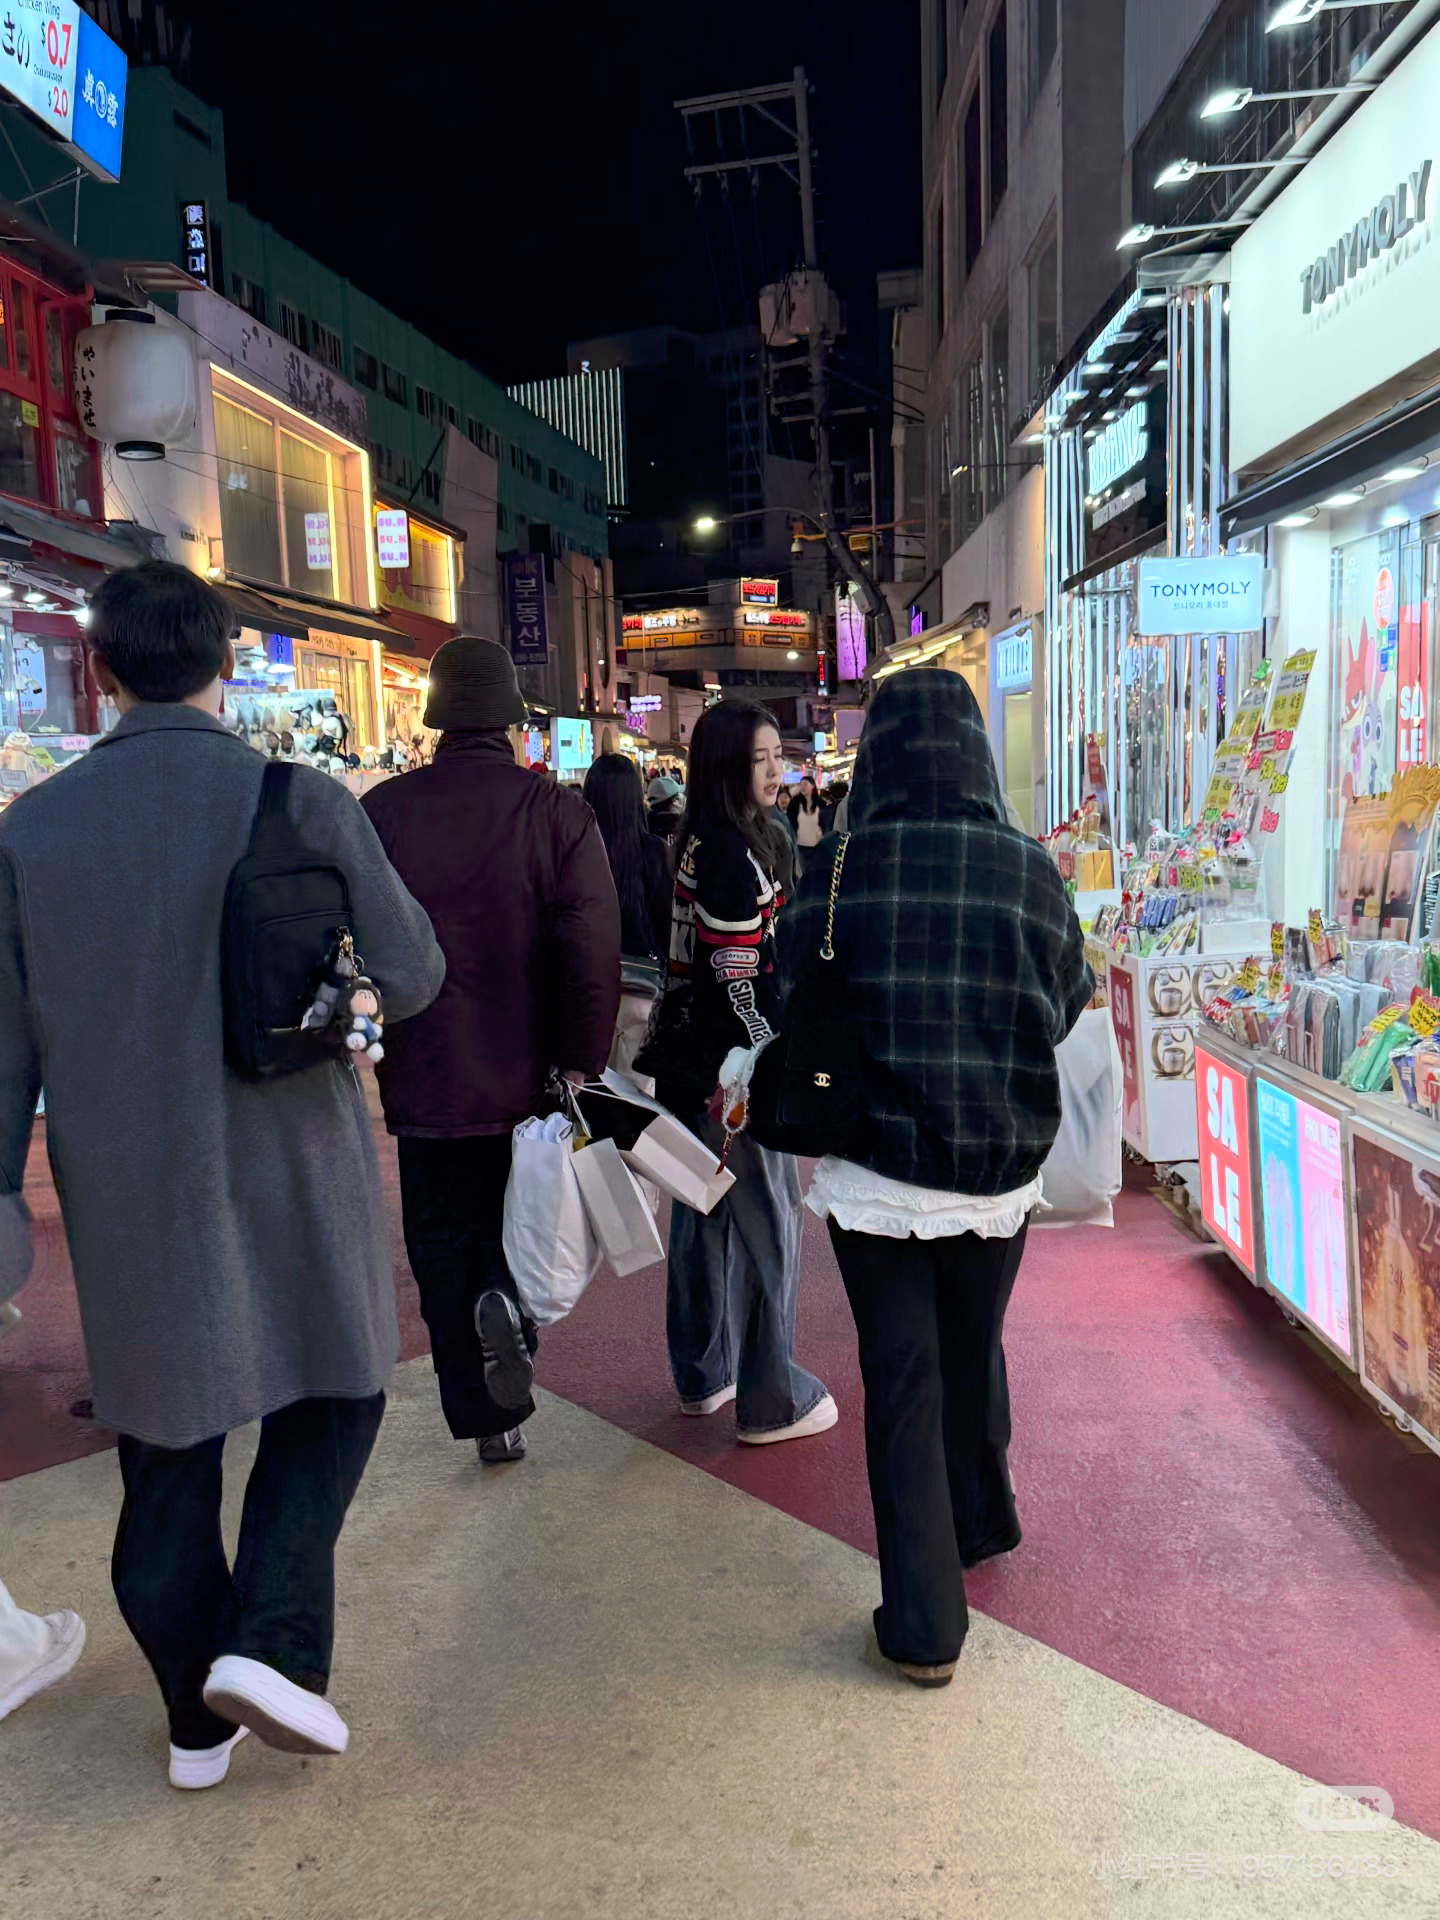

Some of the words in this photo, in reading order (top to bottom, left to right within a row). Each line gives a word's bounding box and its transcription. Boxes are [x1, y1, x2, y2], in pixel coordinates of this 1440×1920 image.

[1300, 159, 1432, 314] TONYMOLY
[514, 577, 542, 648] 부동산
[1150, 580, 1251, 598] TONYMOLY
[1400, 685, 1425, 721] SA
[1400, 728, 1423, 762] LE
[1206, 1065, 1239, 1154] SA
[1210, 1153, 1242, 1249] LE
